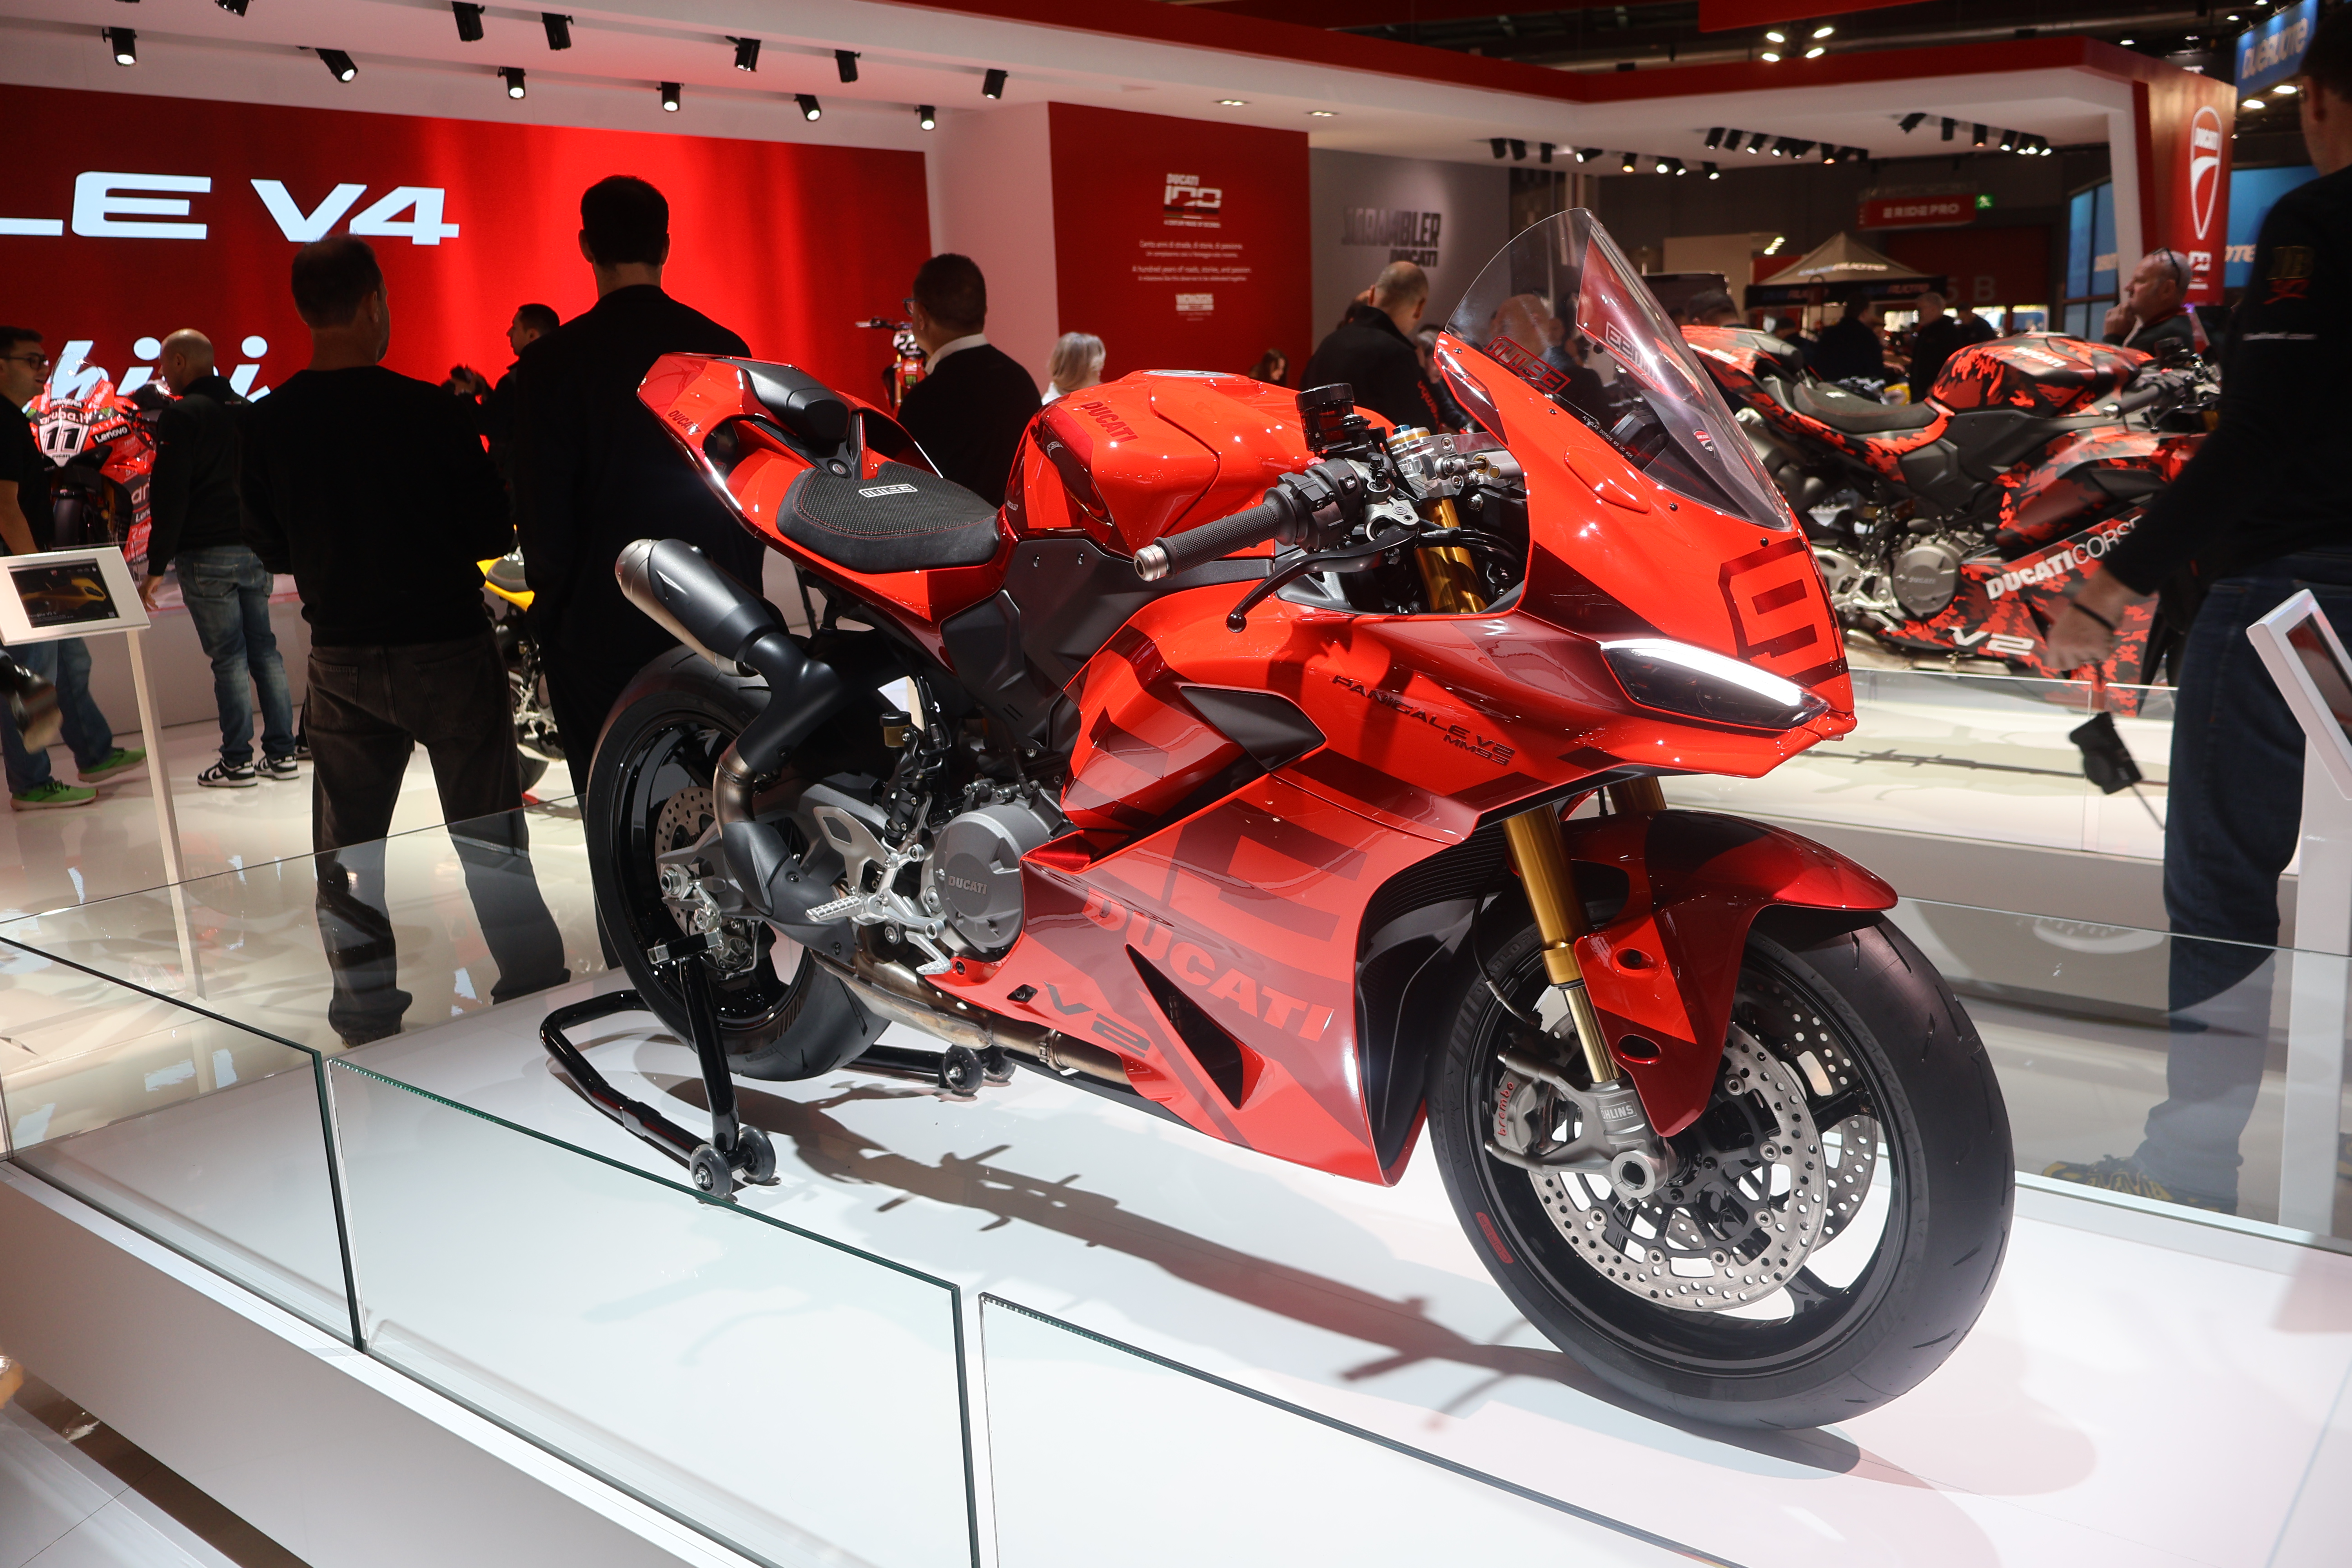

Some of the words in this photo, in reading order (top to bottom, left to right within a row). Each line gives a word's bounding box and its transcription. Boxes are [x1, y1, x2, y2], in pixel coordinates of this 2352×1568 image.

[250, 179, 460, 245] V4
[95, 426, 128, 443] Lenovo
[1080, 401, 1139, 443] DUCATI
[1948, 626, 2035, 657] V2
[1332, 675, 1470, 739] PANIGALE
[1476, 734, 1515, 759] V2
[1443, 733, 1510, 766] MM93
[949, 875, 987, 895] DUCATI
[1081, 886, 1335, 1042] DUCATI
[1043, 981, 1151, 1058] V2
[1497, 1082, 1514, 1136] brembo
